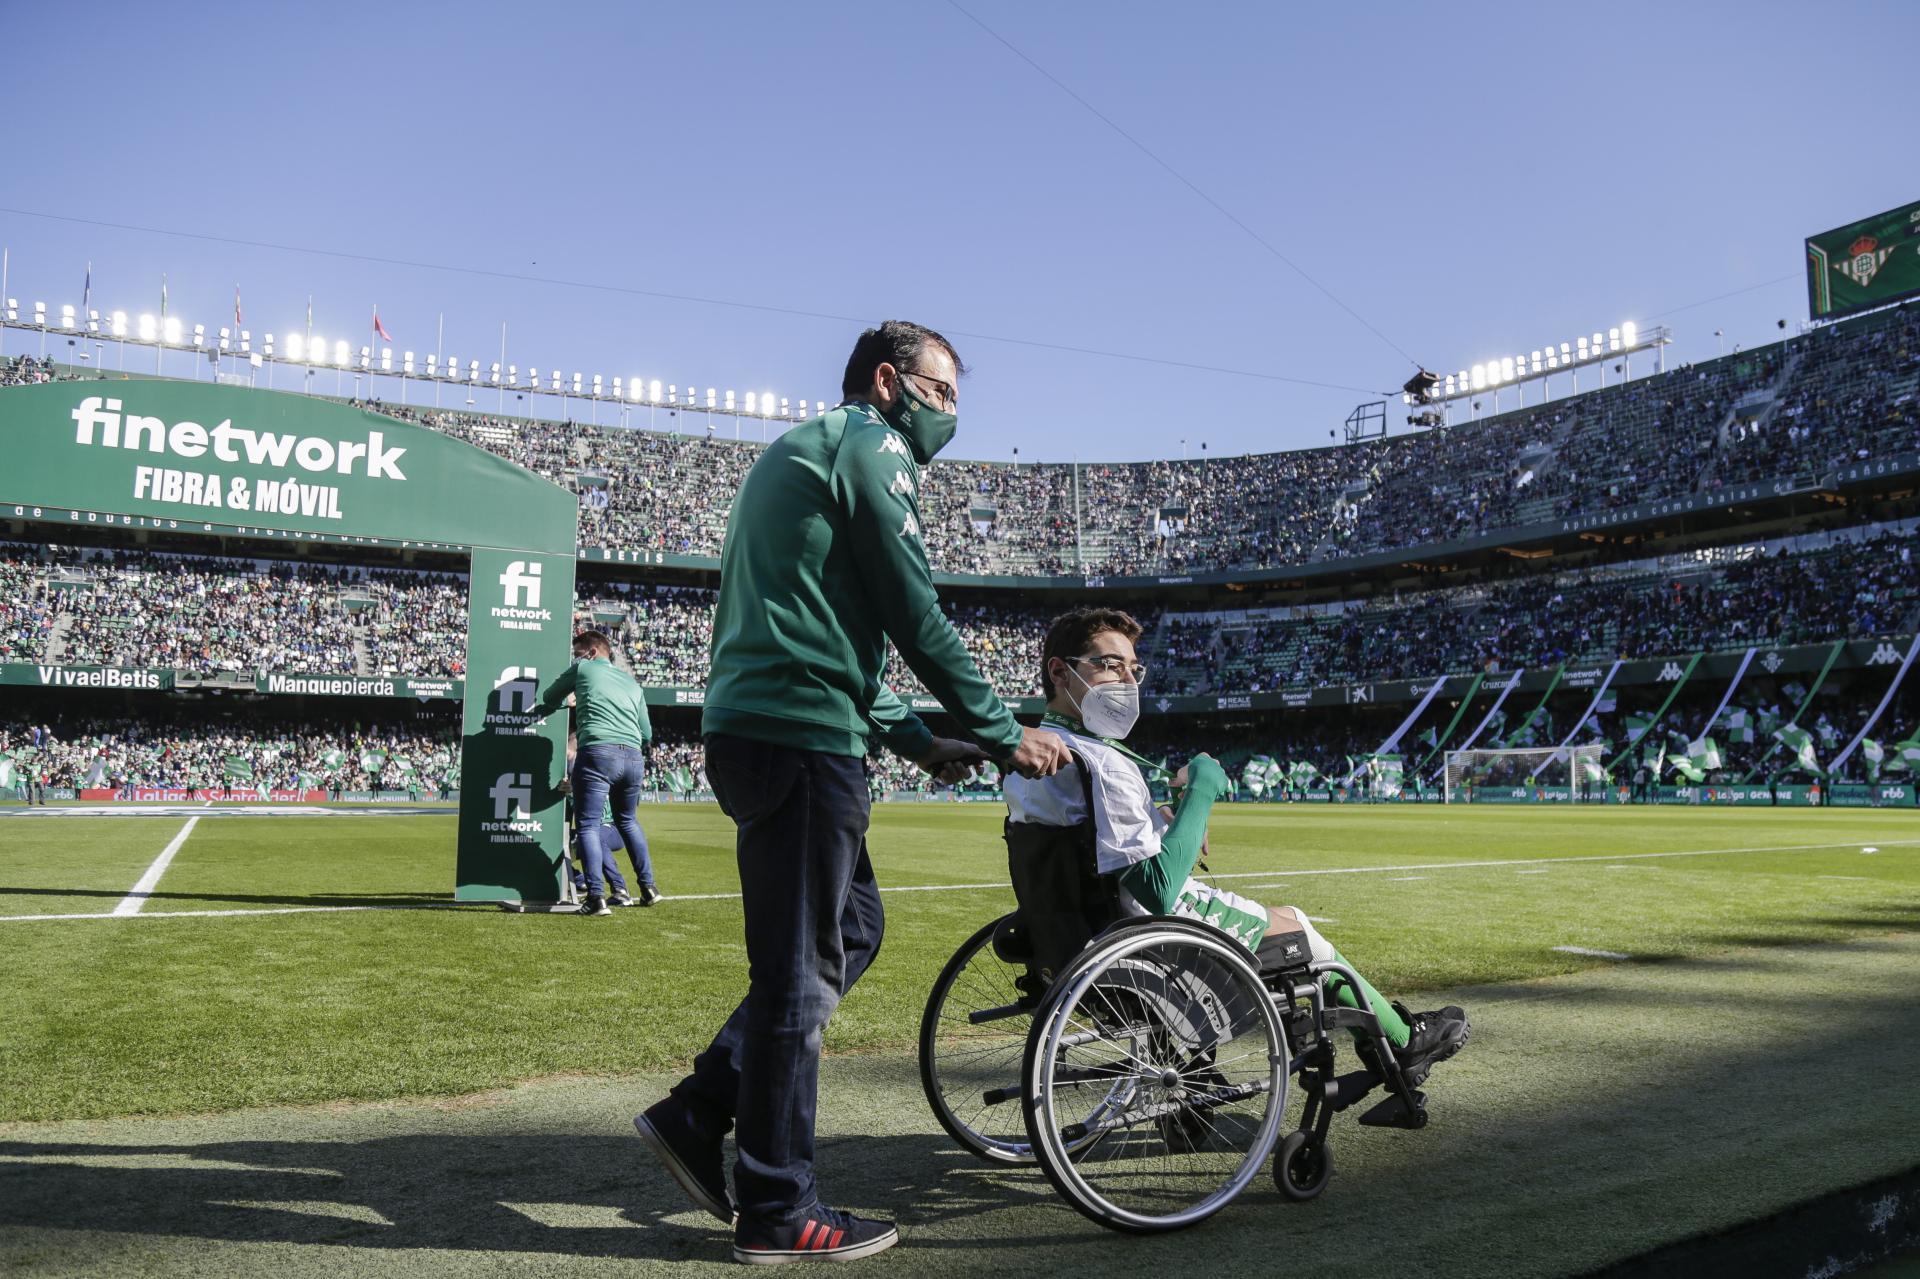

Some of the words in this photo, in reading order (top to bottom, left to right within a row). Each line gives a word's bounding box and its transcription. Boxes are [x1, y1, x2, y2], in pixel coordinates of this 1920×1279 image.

[71, 396, 407, 481] finetwork
[134, 466, 222, 507] FIBRA
[227, 478, 250, 510] &
[255, 476, 342, 519] MÓVIL
[603, 550, 664, 564] BETIS
[499, 561, 542, 608] fi
[491, 607, 552, 620] network
[269, 674, 394, 696] Manquepierda
[407, 680, 453, 691] finetwork
[494, 666, 537, 713] fi
[486, 713, 547, 726] network
[489, 772, 532, 820] fi
[1882, 787, 1905, 798] rbb
[481, 820, 543, 832] network
